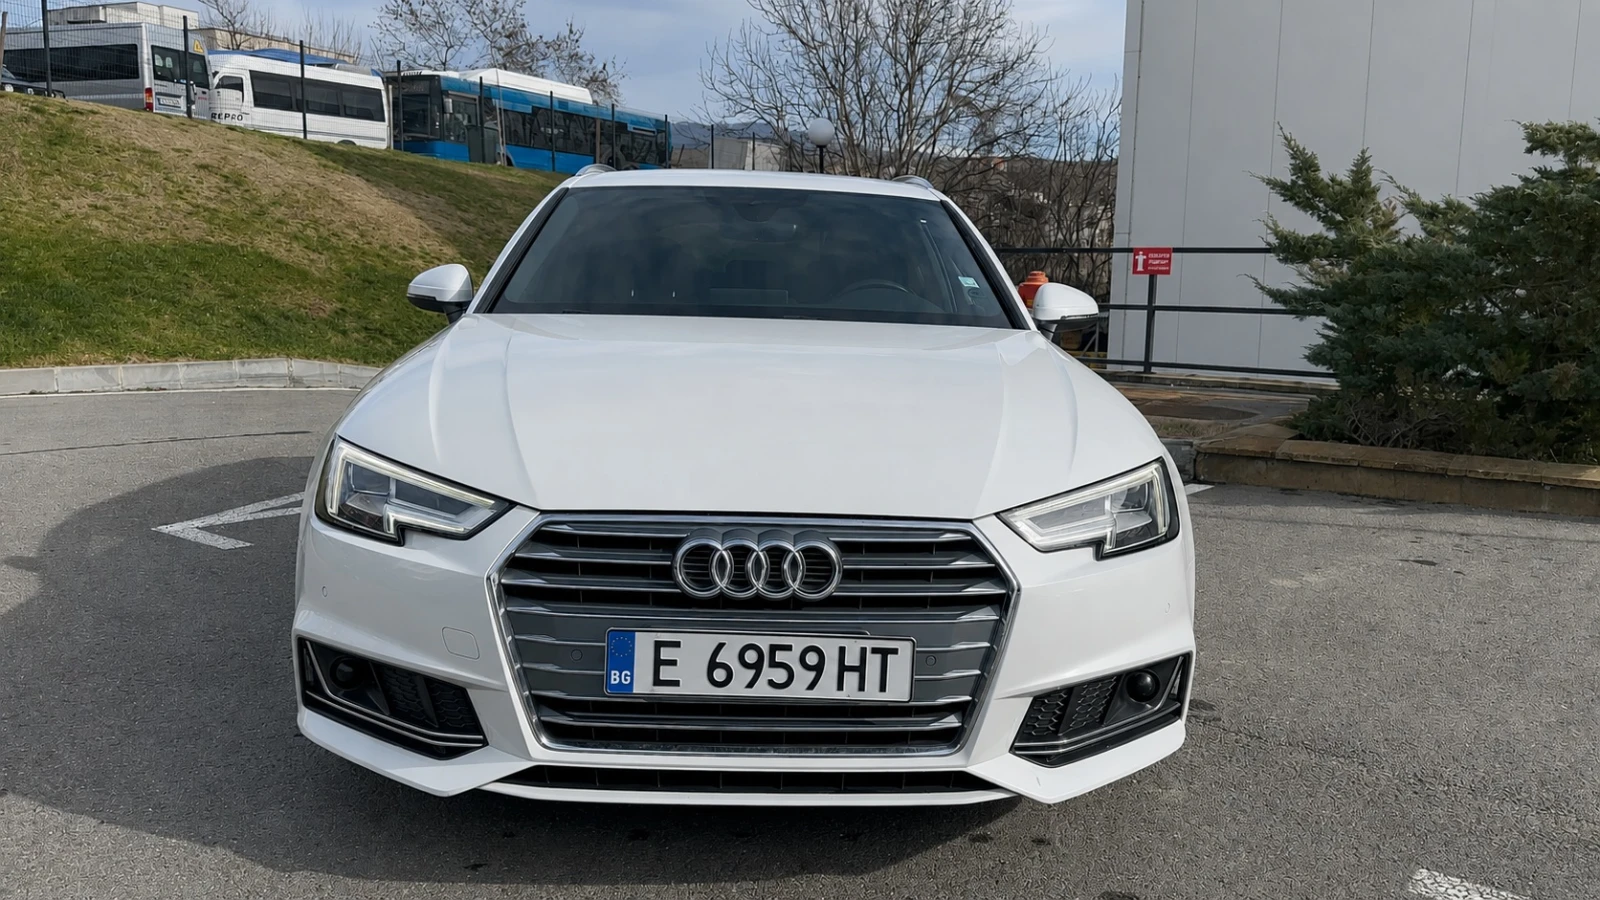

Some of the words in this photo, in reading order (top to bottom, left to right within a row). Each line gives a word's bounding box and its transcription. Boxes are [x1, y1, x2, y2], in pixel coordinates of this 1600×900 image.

[610, 670, 631, 685] BG
[653, 640, 681, 687] E
[706, 642, 826, 690] 6959
